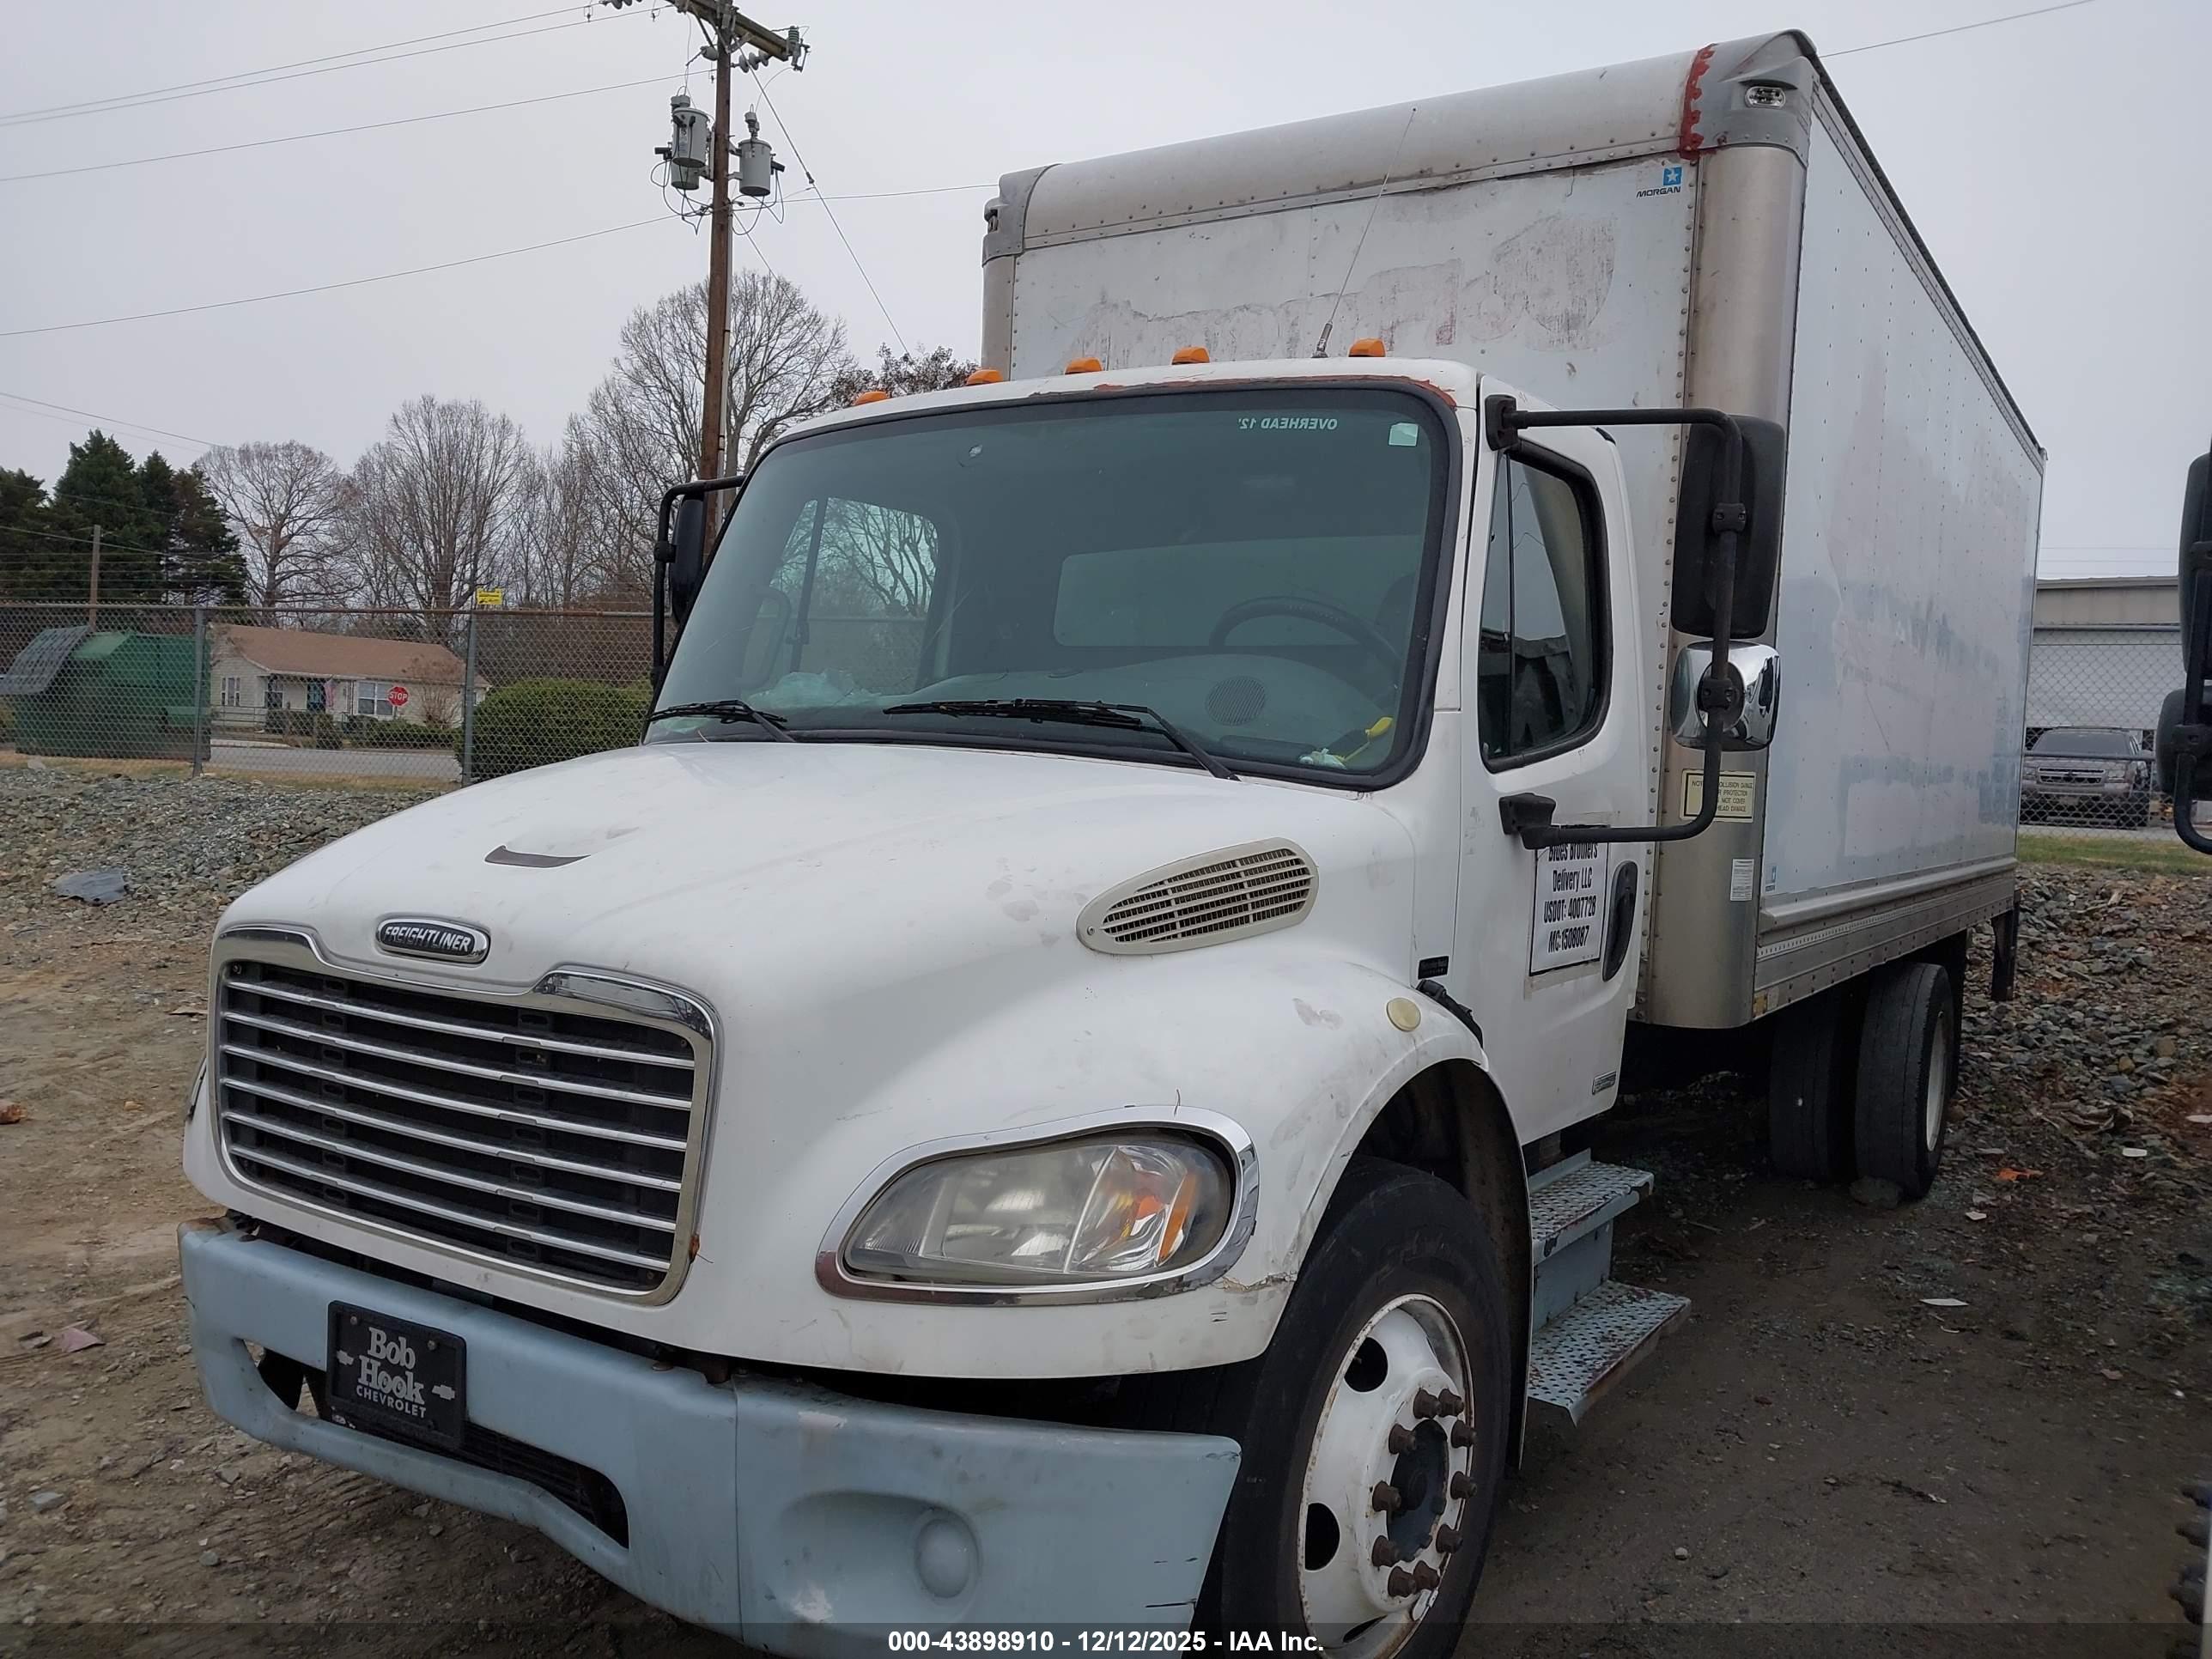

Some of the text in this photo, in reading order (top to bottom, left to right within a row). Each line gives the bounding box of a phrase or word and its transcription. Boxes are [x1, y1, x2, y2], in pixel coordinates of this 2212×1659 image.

[1636, 185, 1681, 198] MORGAN
[389, 691, 408, 701] STOP
[1553, 866, 1593, 892] Delivery LLC
[1543, 896, 1596, 923] USDOT: 4007728
[384, 927, 471, 951] FREIGHTLINER
[368, 1327, 416, 1370] Bob
[357, 1354, 425, 1405] Hook
[356, 1384, 427, 1419] CHEVROLET
